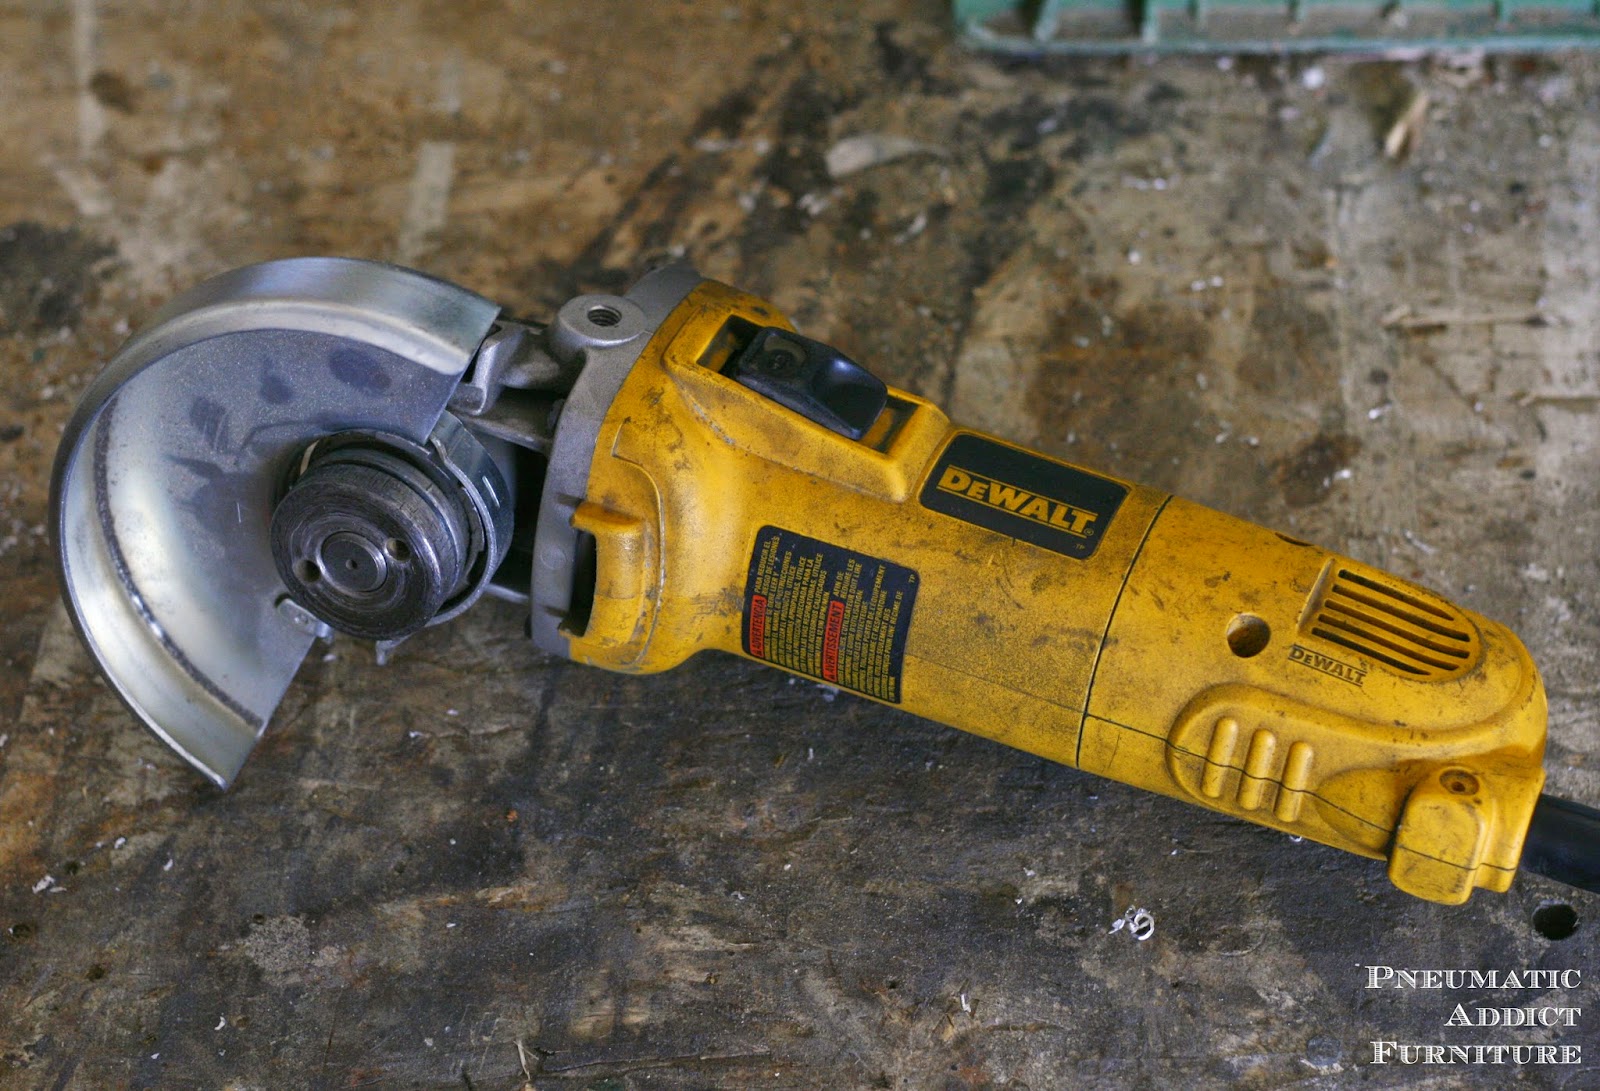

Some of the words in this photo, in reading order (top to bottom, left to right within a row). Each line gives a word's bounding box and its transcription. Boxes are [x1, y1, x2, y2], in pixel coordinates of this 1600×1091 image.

[763, 539, 770, 548] EL
[767, 535, 780, 565] LESIONES
[757, 548, 768, 575] REDUCIR
[765, 565, 772, 574] DE
[795, 555, 806, 580] UTILICE
[806, 558, 813, 568] LA
[811, 552, 823, 577] UTILICE
[846, 558, 855, 571] LES
[786, 565, 796, 588] UTILICE
[802, 568, 811, 585] PARA
[836, 571, 844, 580] DE
[852, 562, 862, 578] LIRE
[753, 576, 762, 592] PARA
[761, 574, 770, 595] RIESGO
[812, 569, 826, 609] CALIFICADOS
[833, 581, 841, 596] AFIN
[849, 578, 857, 593] DOIT
[796, 585, 807, 618] ADECUADA
[895, 590, 902, 599] DE
[867, 610, 874, 619] DE
[872, 589, 887, 631] RESPIRATOIRE
[882, 607, 890, 620] DES
[752, 597, 764, 648] ADVERTENCIA
[826, 603, 841, 672] AVERTISSEMENT
